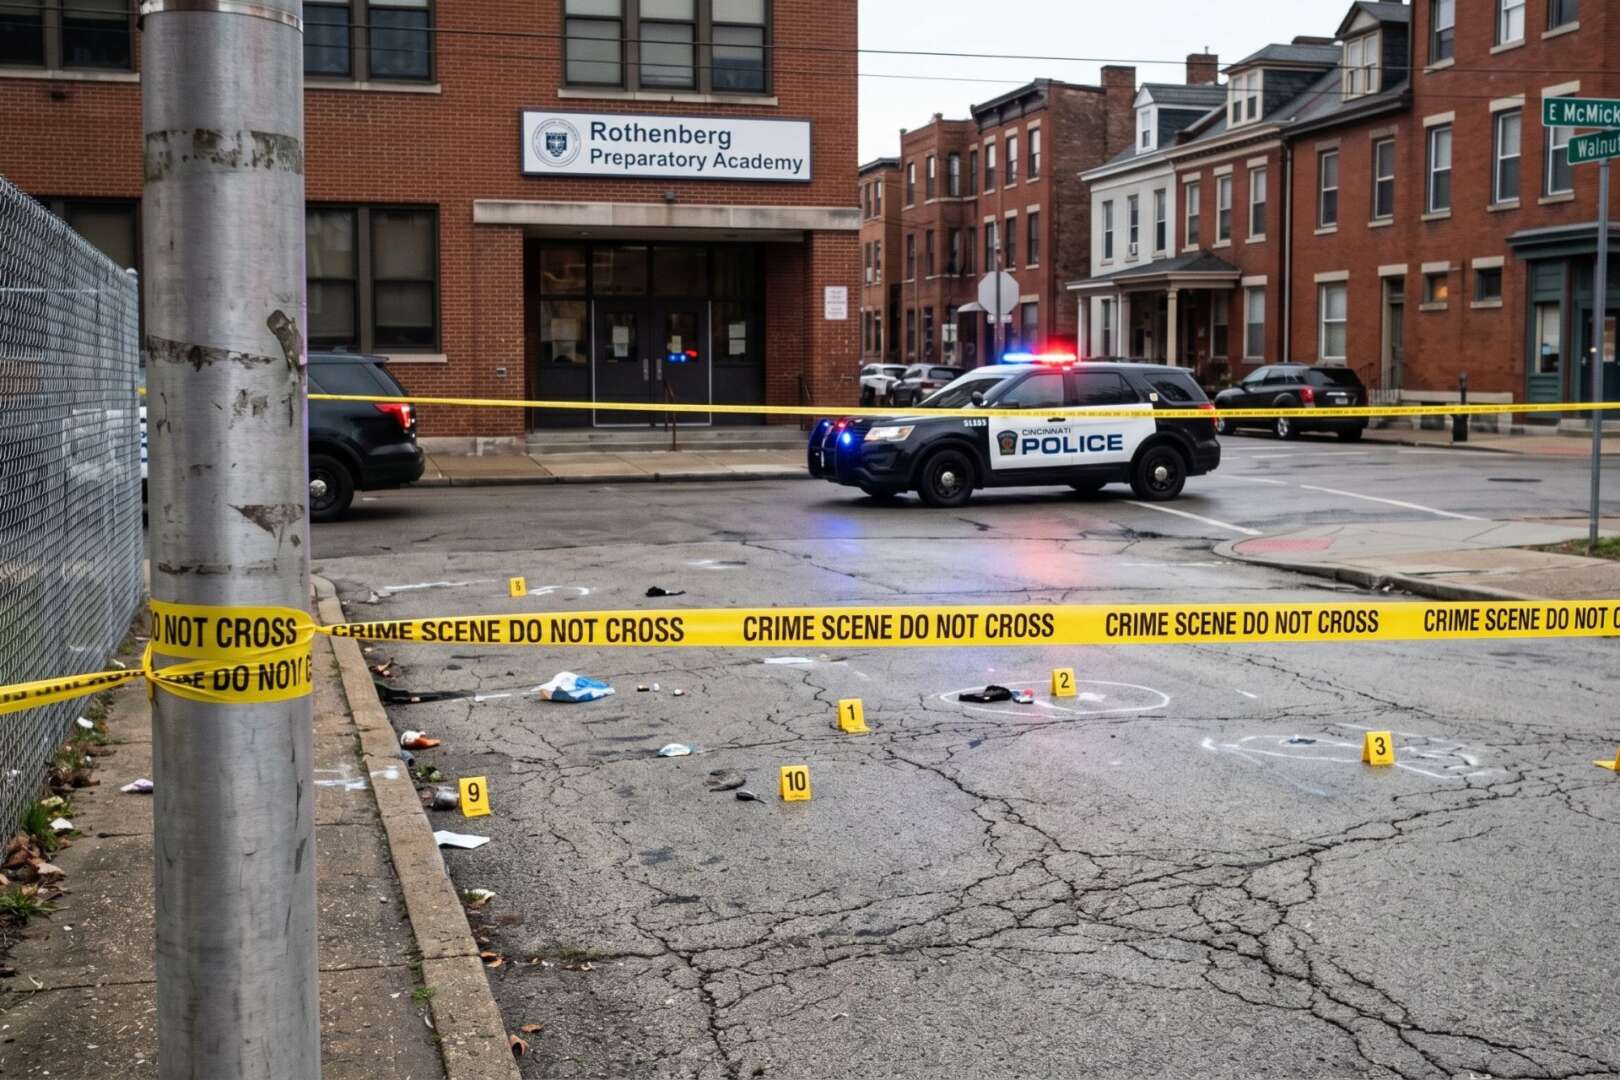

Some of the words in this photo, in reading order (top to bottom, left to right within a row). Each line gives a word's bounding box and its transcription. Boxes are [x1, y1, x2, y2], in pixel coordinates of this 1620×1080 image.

[1549, 103, 1557, 120] E
[590, 121, 731, 150] Rothenberg
[590, 148, 707, 171] Preparatory
[712, 152, 803, 174] Academy
[1022, 427, 1071, 436] CINCINNATI
[1022, 434, 1123, 455] POLICE
[165, 614, 208, 647] NOT
[216, 617, 297, 648] CROSS
[331, 620, 413, 640] CRIME
[421, 619, 500, 642] SCENE
[509, 618, 543, 643] DO
[551, 618, 598, 643] NOT
[606, 616, 685, 643] CROSS
[743, 615, 815, 641] CRIME
[821, 614, 892, 640] SCENE
[900, 614, 929, 640] DO
[936, 613, 978, 639] NOT
[985, 612, 1055, 638] CROSS
[1105, 612, 1168, 636] CRIME
[1175, 611, 1237, 635] SCENE
[1243, 611, 1269, 635] DO
[1275, 610, 1312, 634] NOT
[1318, 610, 1379, 633] CROSS
[1424, 608, 1480, 632] CRIME
[1485, 608, 1540, 631] SCENE
[1546, 607, 1569, 630] DO
[1575, 607, 1608, 629] NOT
[213, 665, 250, 692] DO
[1060, 672, 1070, 688] 2
[847, 704, 855, 720] 1
[1375, 736, 1386, 756] 3
[468, 782, 480, 802] 9
[785, 771, 806, 791] 10
